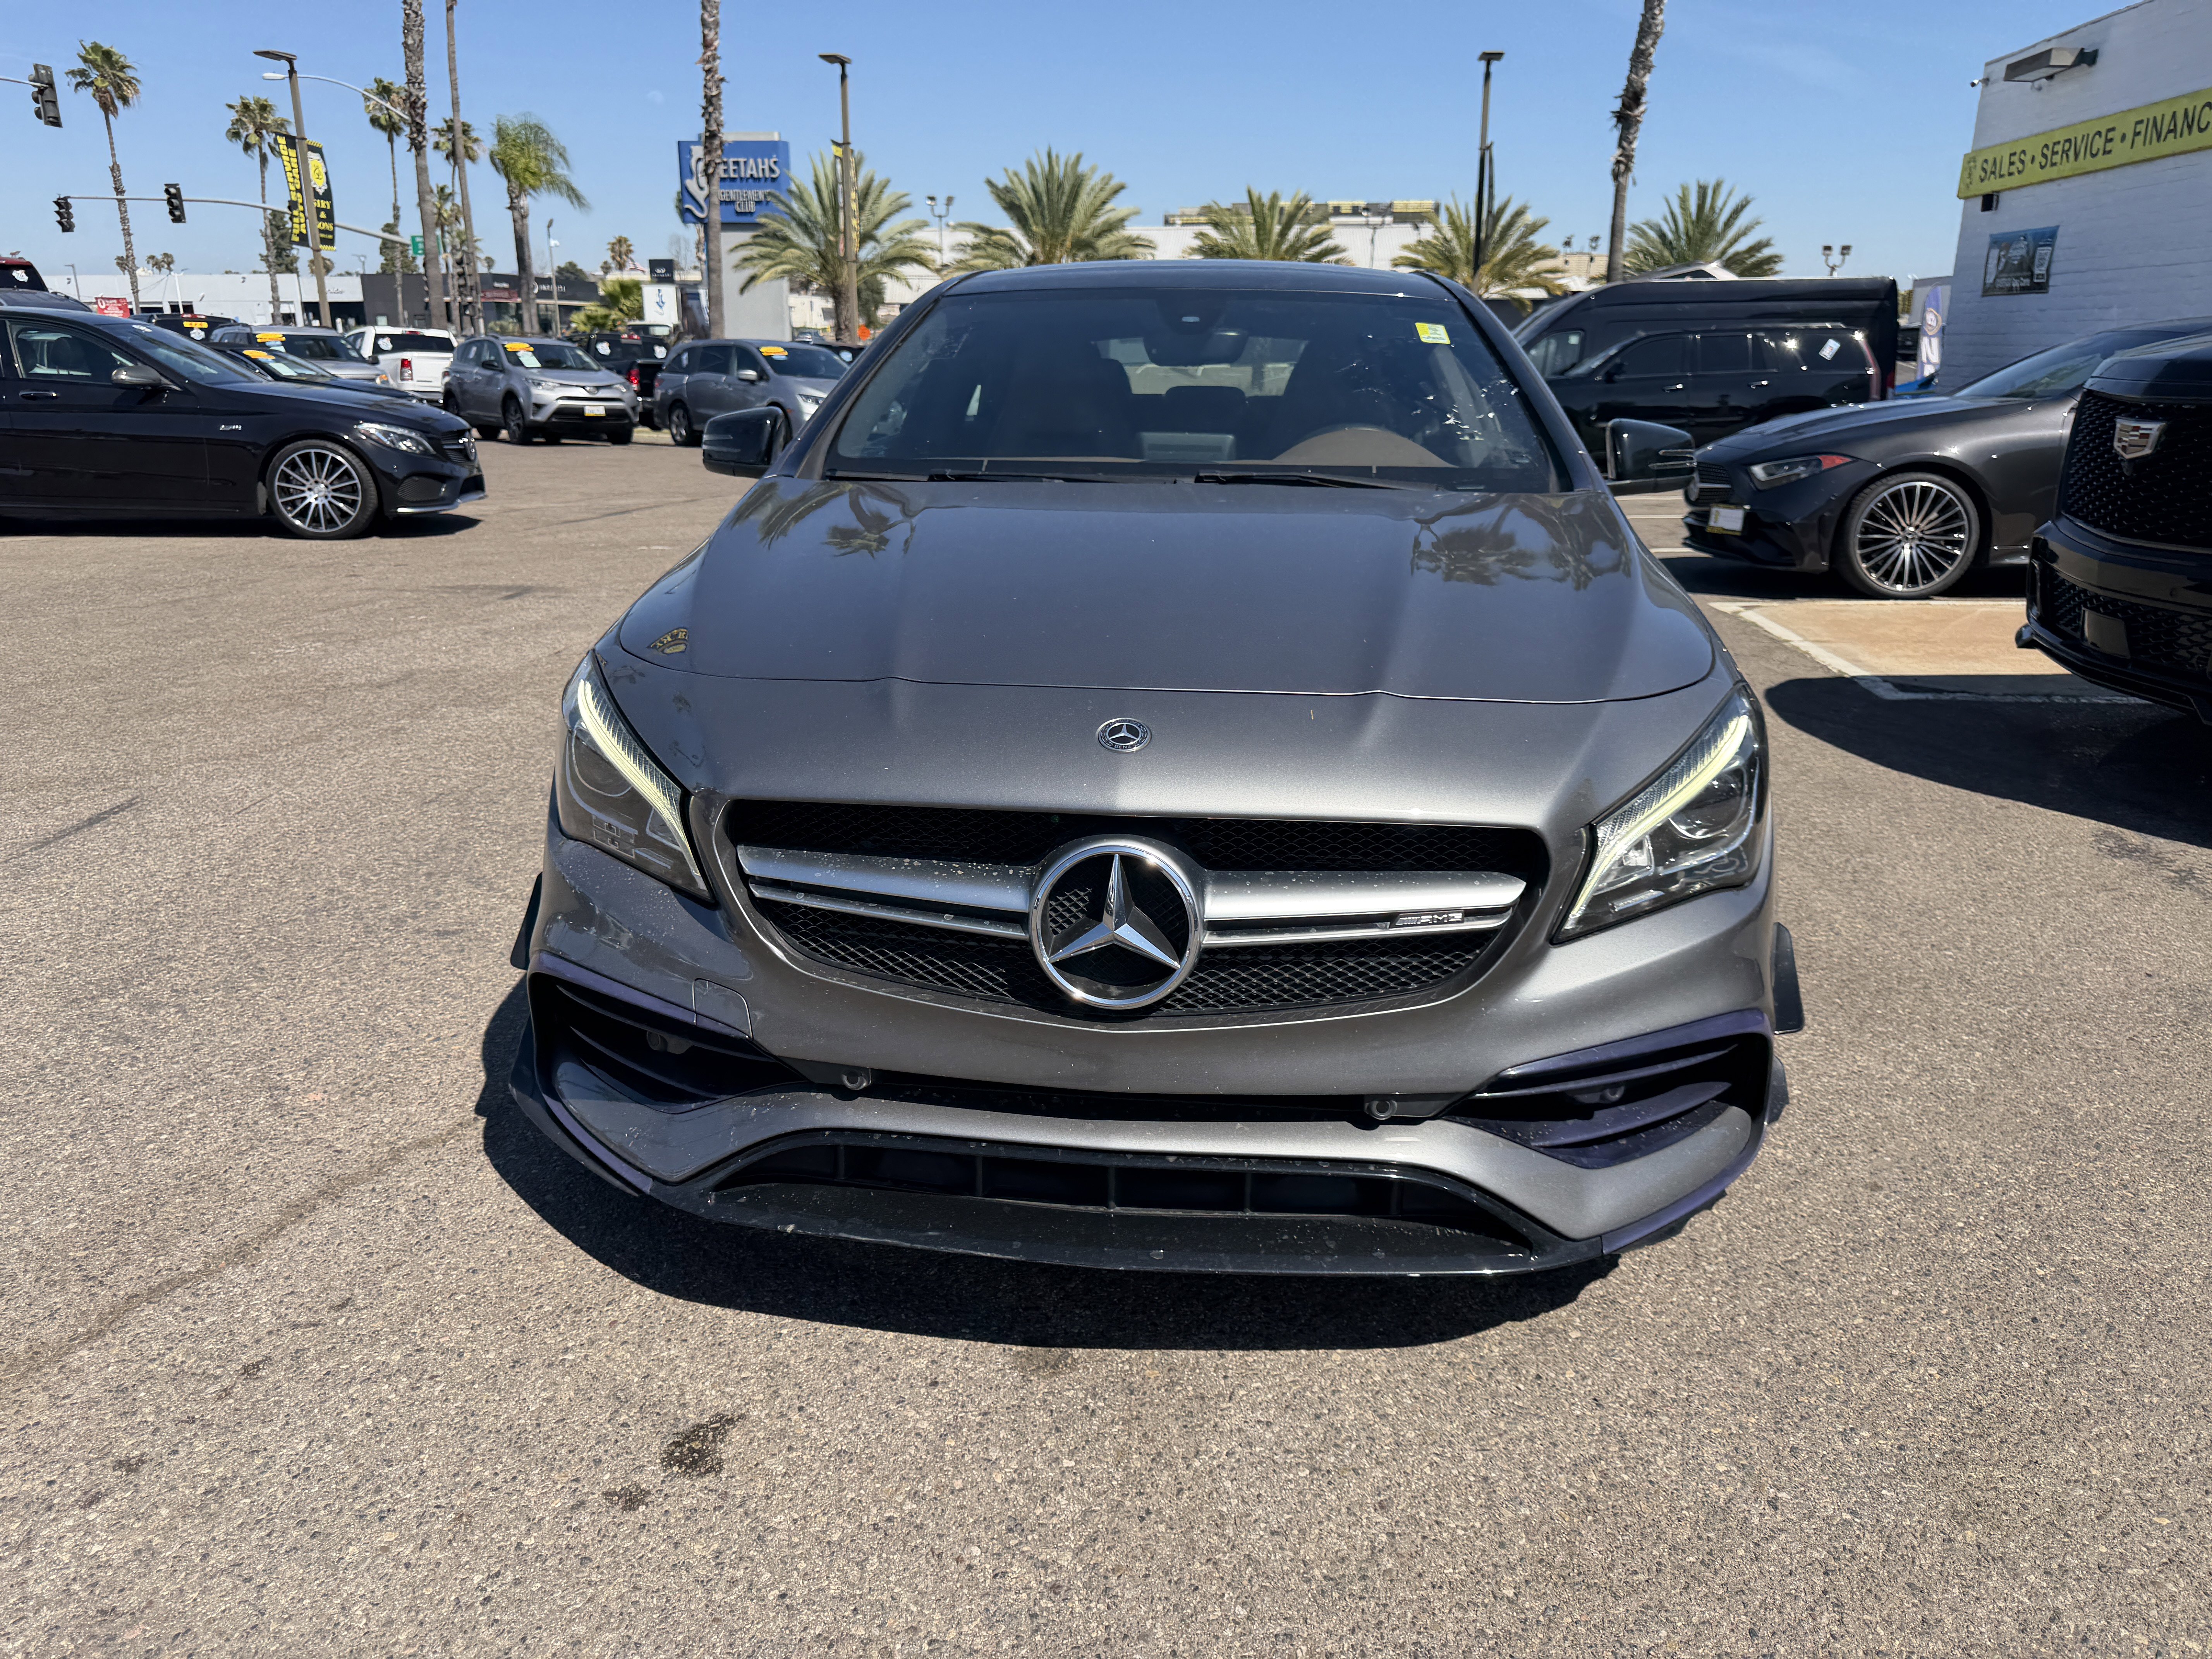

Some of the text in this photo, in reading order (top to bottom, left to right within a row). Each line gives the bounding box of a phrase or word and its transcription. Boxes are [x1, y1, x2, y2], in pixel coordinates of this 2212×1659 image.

[1979, 149, 2026, 183] SALES
[2039, 126, 2116, 170] SERVICE
[2130, 101, 2212, 149] FINANC
[276, 135, 300, 242] FULL SERVICE
[288, 148, 307, 234] AUTO CARE
[719, 158, 780, 178] EETAHS
[317, 221, 334, 231] ONS
[735, 201, 756, 212] CLUB
